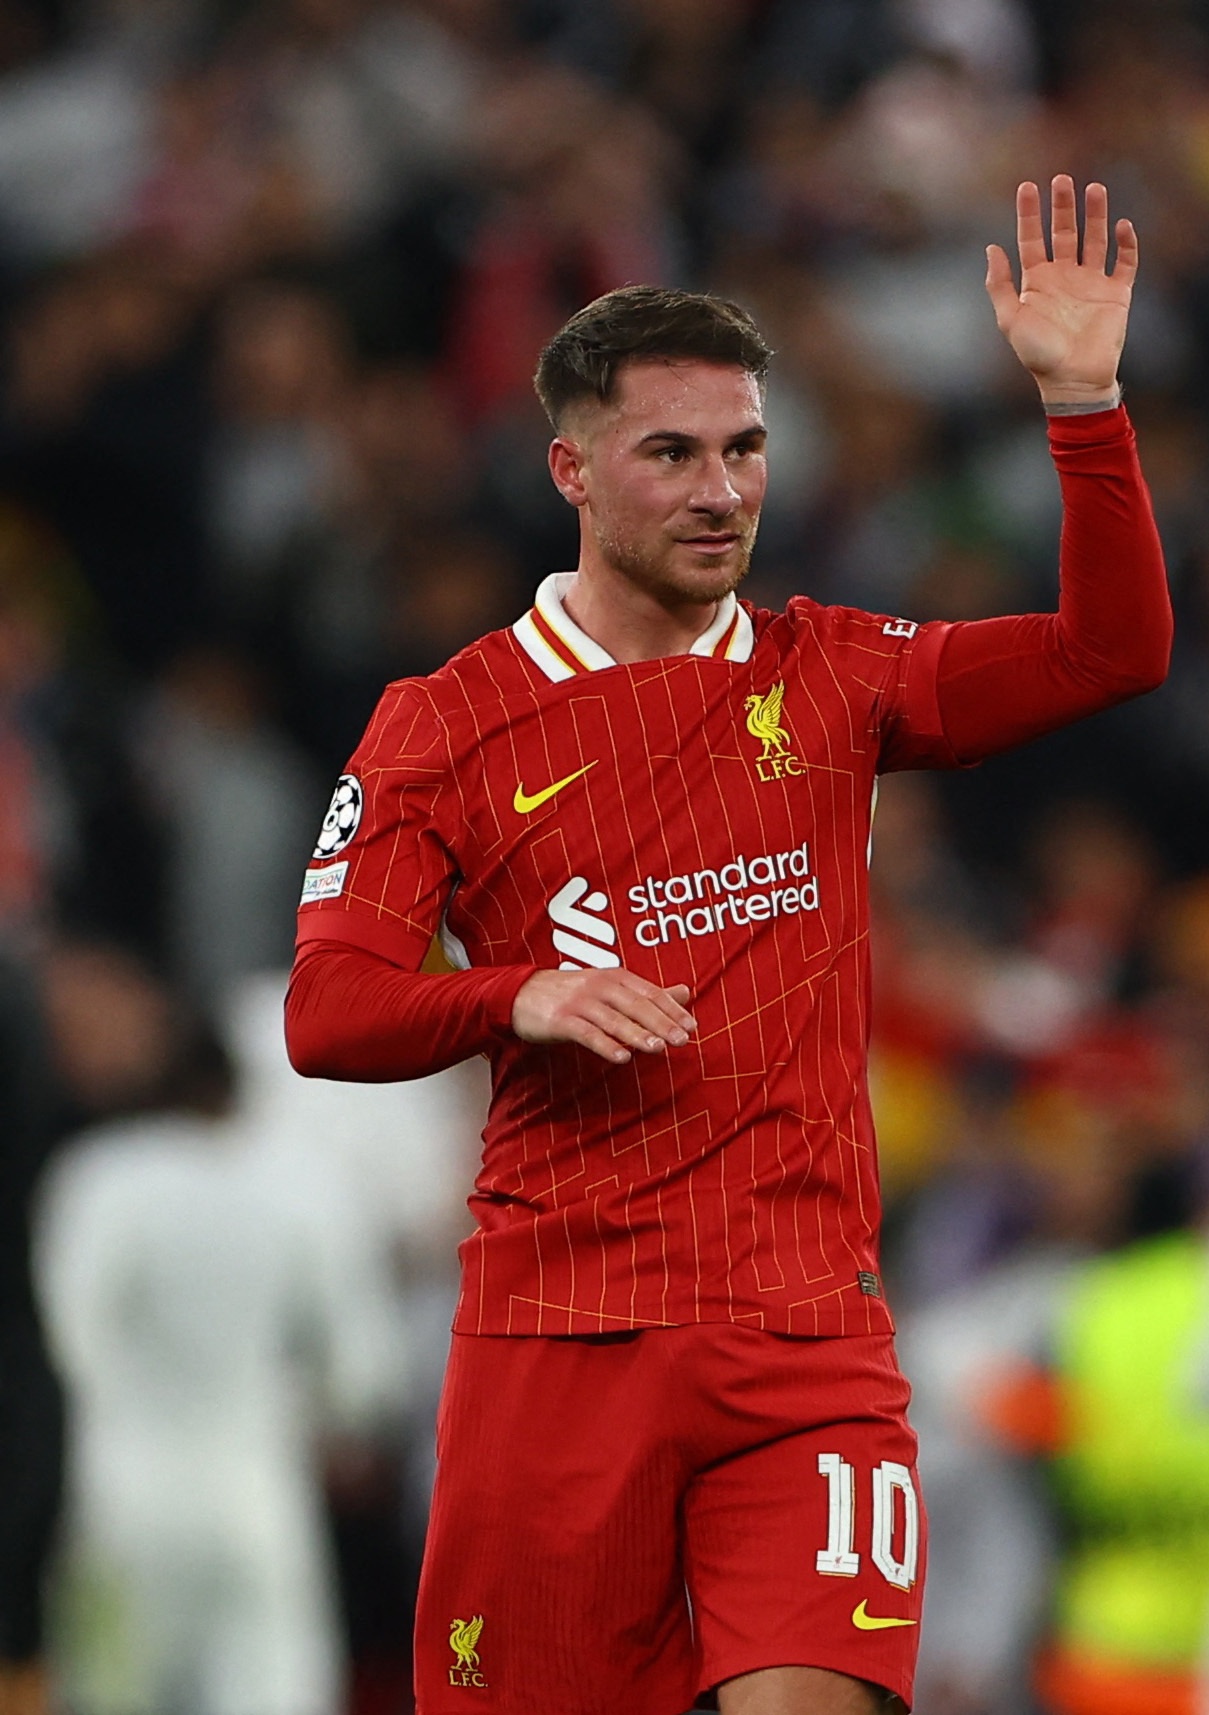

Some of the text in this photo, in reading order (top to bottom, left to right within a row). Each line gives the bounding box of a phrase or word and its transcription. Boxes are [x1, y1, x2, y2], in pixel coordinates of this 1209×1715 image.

[628, 841, 809, 914] standard
[635, 875, 819, 948] chartered
[816, 1453, 918, 1593] 10
[449, 1670, 489, 1687] L.F.C.
